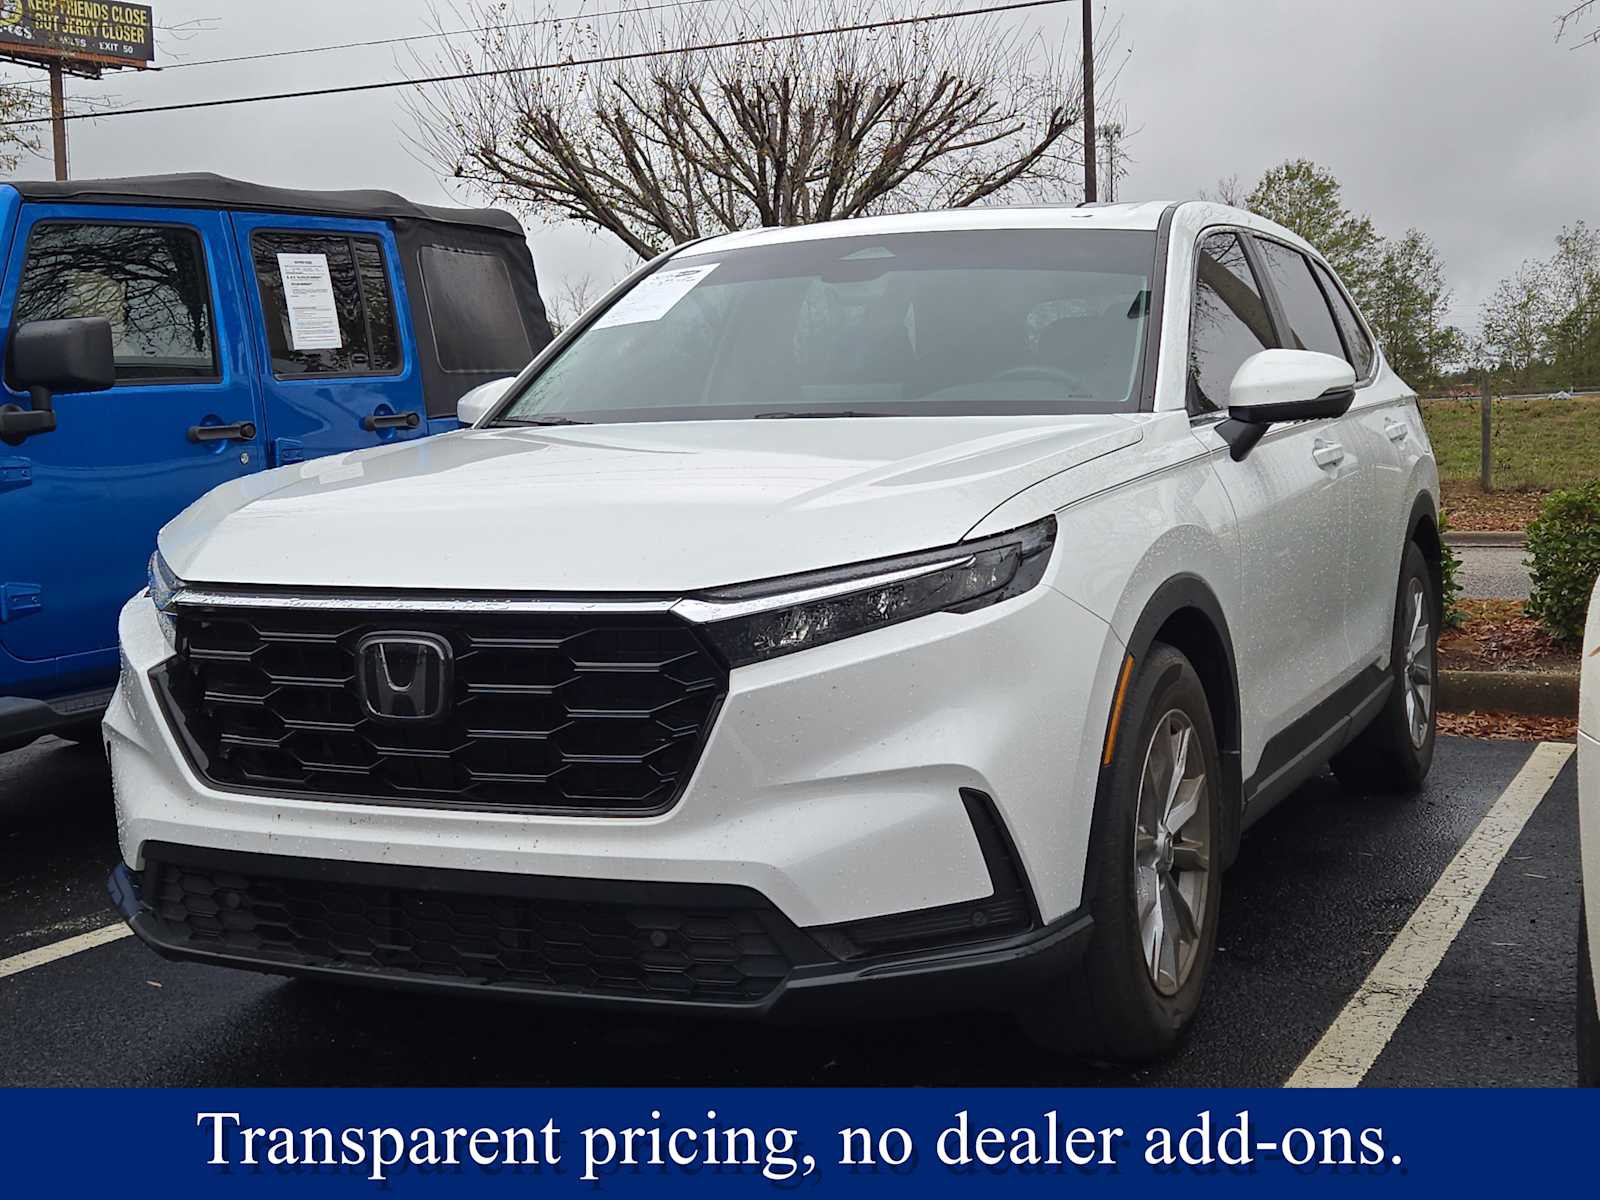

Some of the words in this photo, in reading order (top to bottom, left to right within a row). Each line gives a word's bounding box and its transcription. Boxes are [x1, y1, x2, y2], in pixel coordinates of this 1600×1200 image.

[28, 0, 57, 12] KEEP
[60, 0, 109, 21] FRIENDS
[111, 5, 147, 26] CLOSE
[61, 17, 99, 37] JERKY
[101, 22, 145, 44] CLOSER
[98, 41, 119, 52] EXIT
[122, 44, 134, 54] 50
